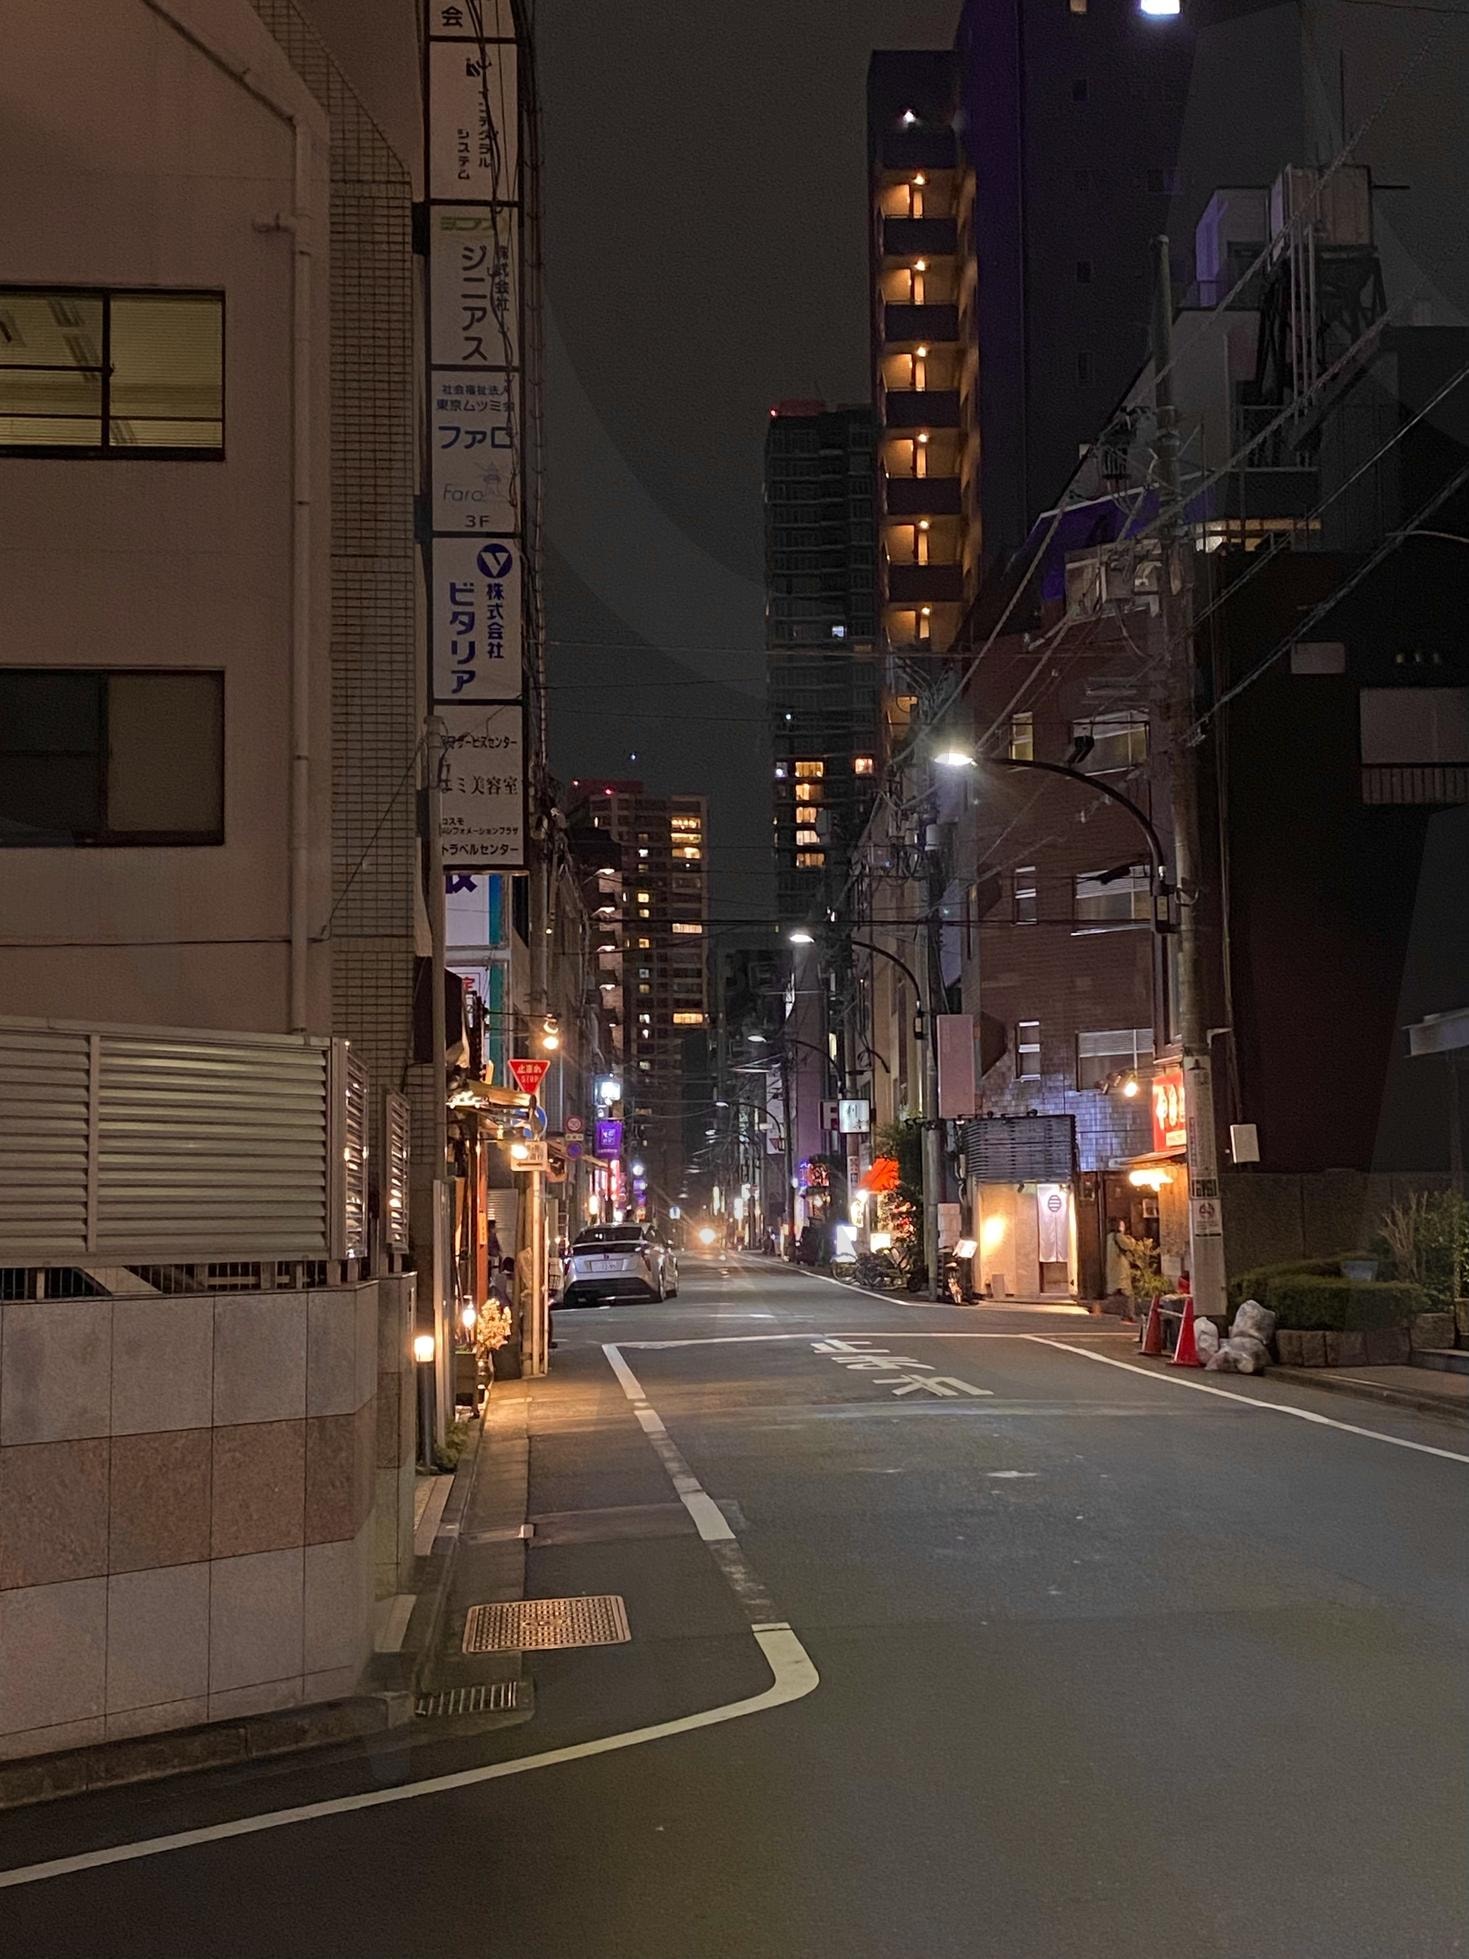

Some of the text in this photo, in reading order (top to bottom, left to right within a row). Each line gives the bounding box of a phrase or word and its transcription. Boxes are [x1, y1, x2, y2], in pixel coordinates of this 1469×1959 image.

[441, 5, 463, 28] 会
[457, 128, 471, 180] システム
[461, 245, 488, 361] ジニアス
[438, 426, 513, 450] ファロ
[464, 515, 491, 528] 3F
[486, 582, 505, 660] 株式会社
[449, 581, 477, 694] ビタリア
[441, 843, 519, 857] トラベルセンター
[516, 1063, 543, 1074] 止まれ
[520, 1075, 540, 1083] STOP
[810, 1338, 994, 1397] 止まれ
